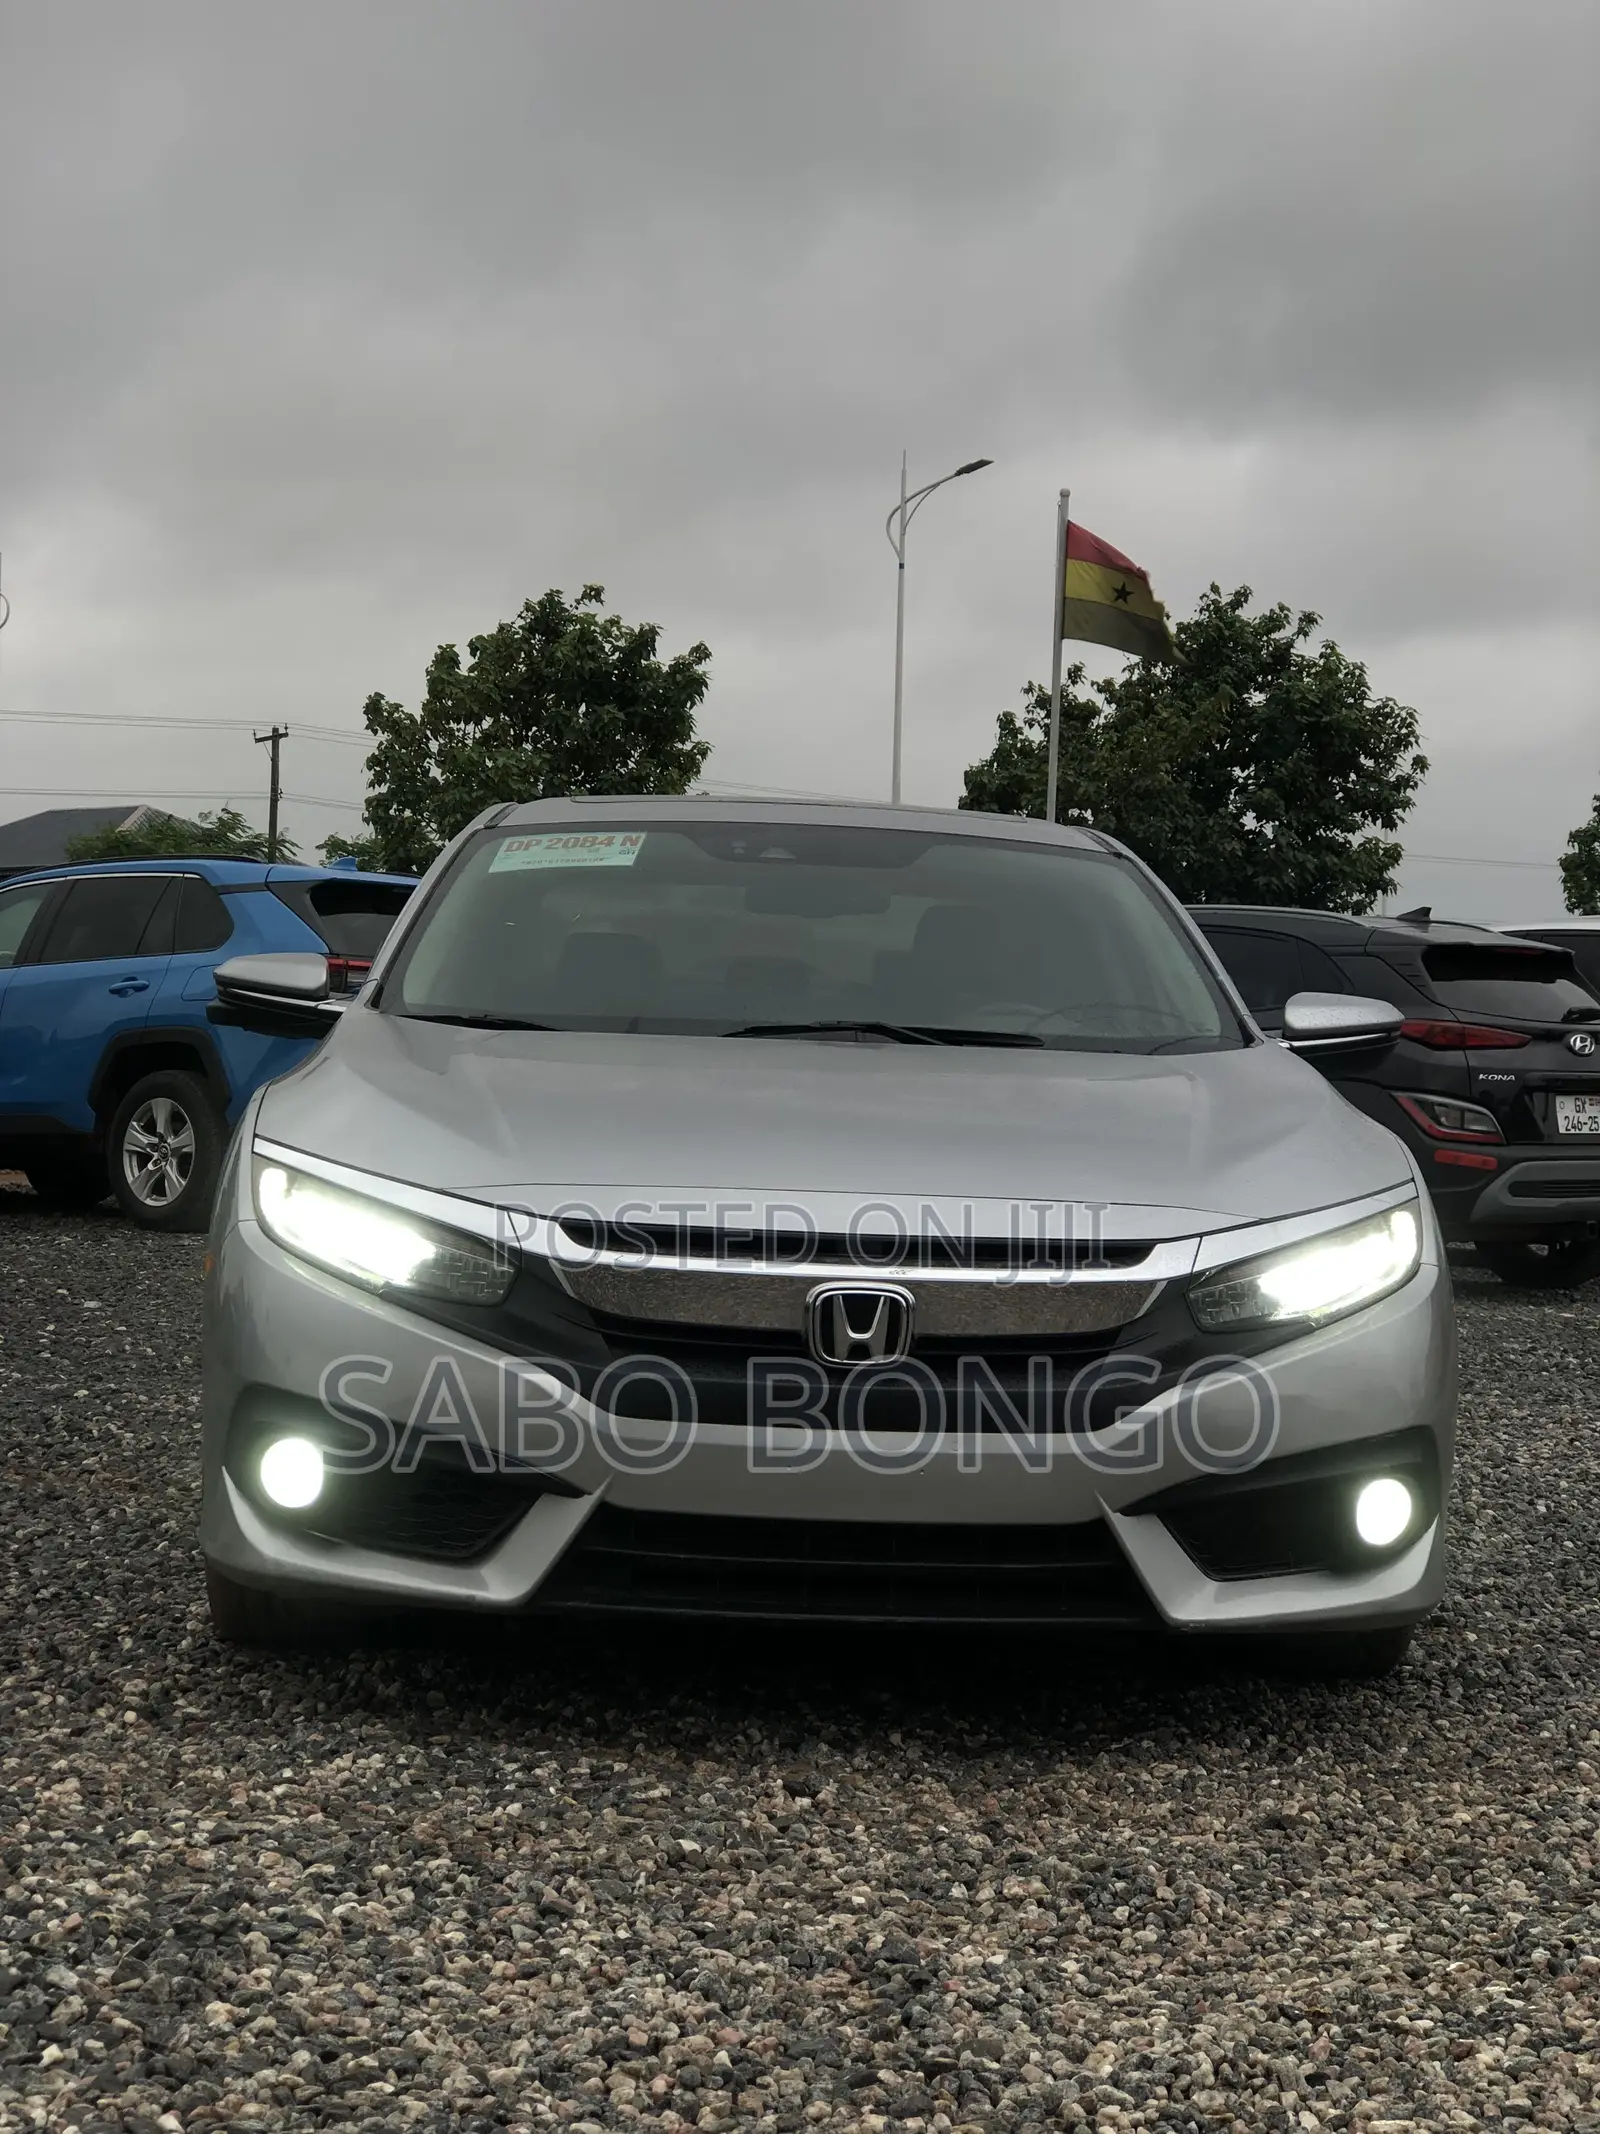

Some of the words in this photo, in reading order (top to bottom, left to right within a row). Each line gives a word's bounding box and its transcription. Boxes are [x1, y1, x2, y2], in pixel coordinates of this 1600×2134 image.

[504, 838, 543, 853] DP
[543, 835, 616, 851] 2084
[620, 835, 642, 847] N
[1478, 1073, 1516, 1082] KONA
[1564, 1115, 1600, 1132] 246-25
